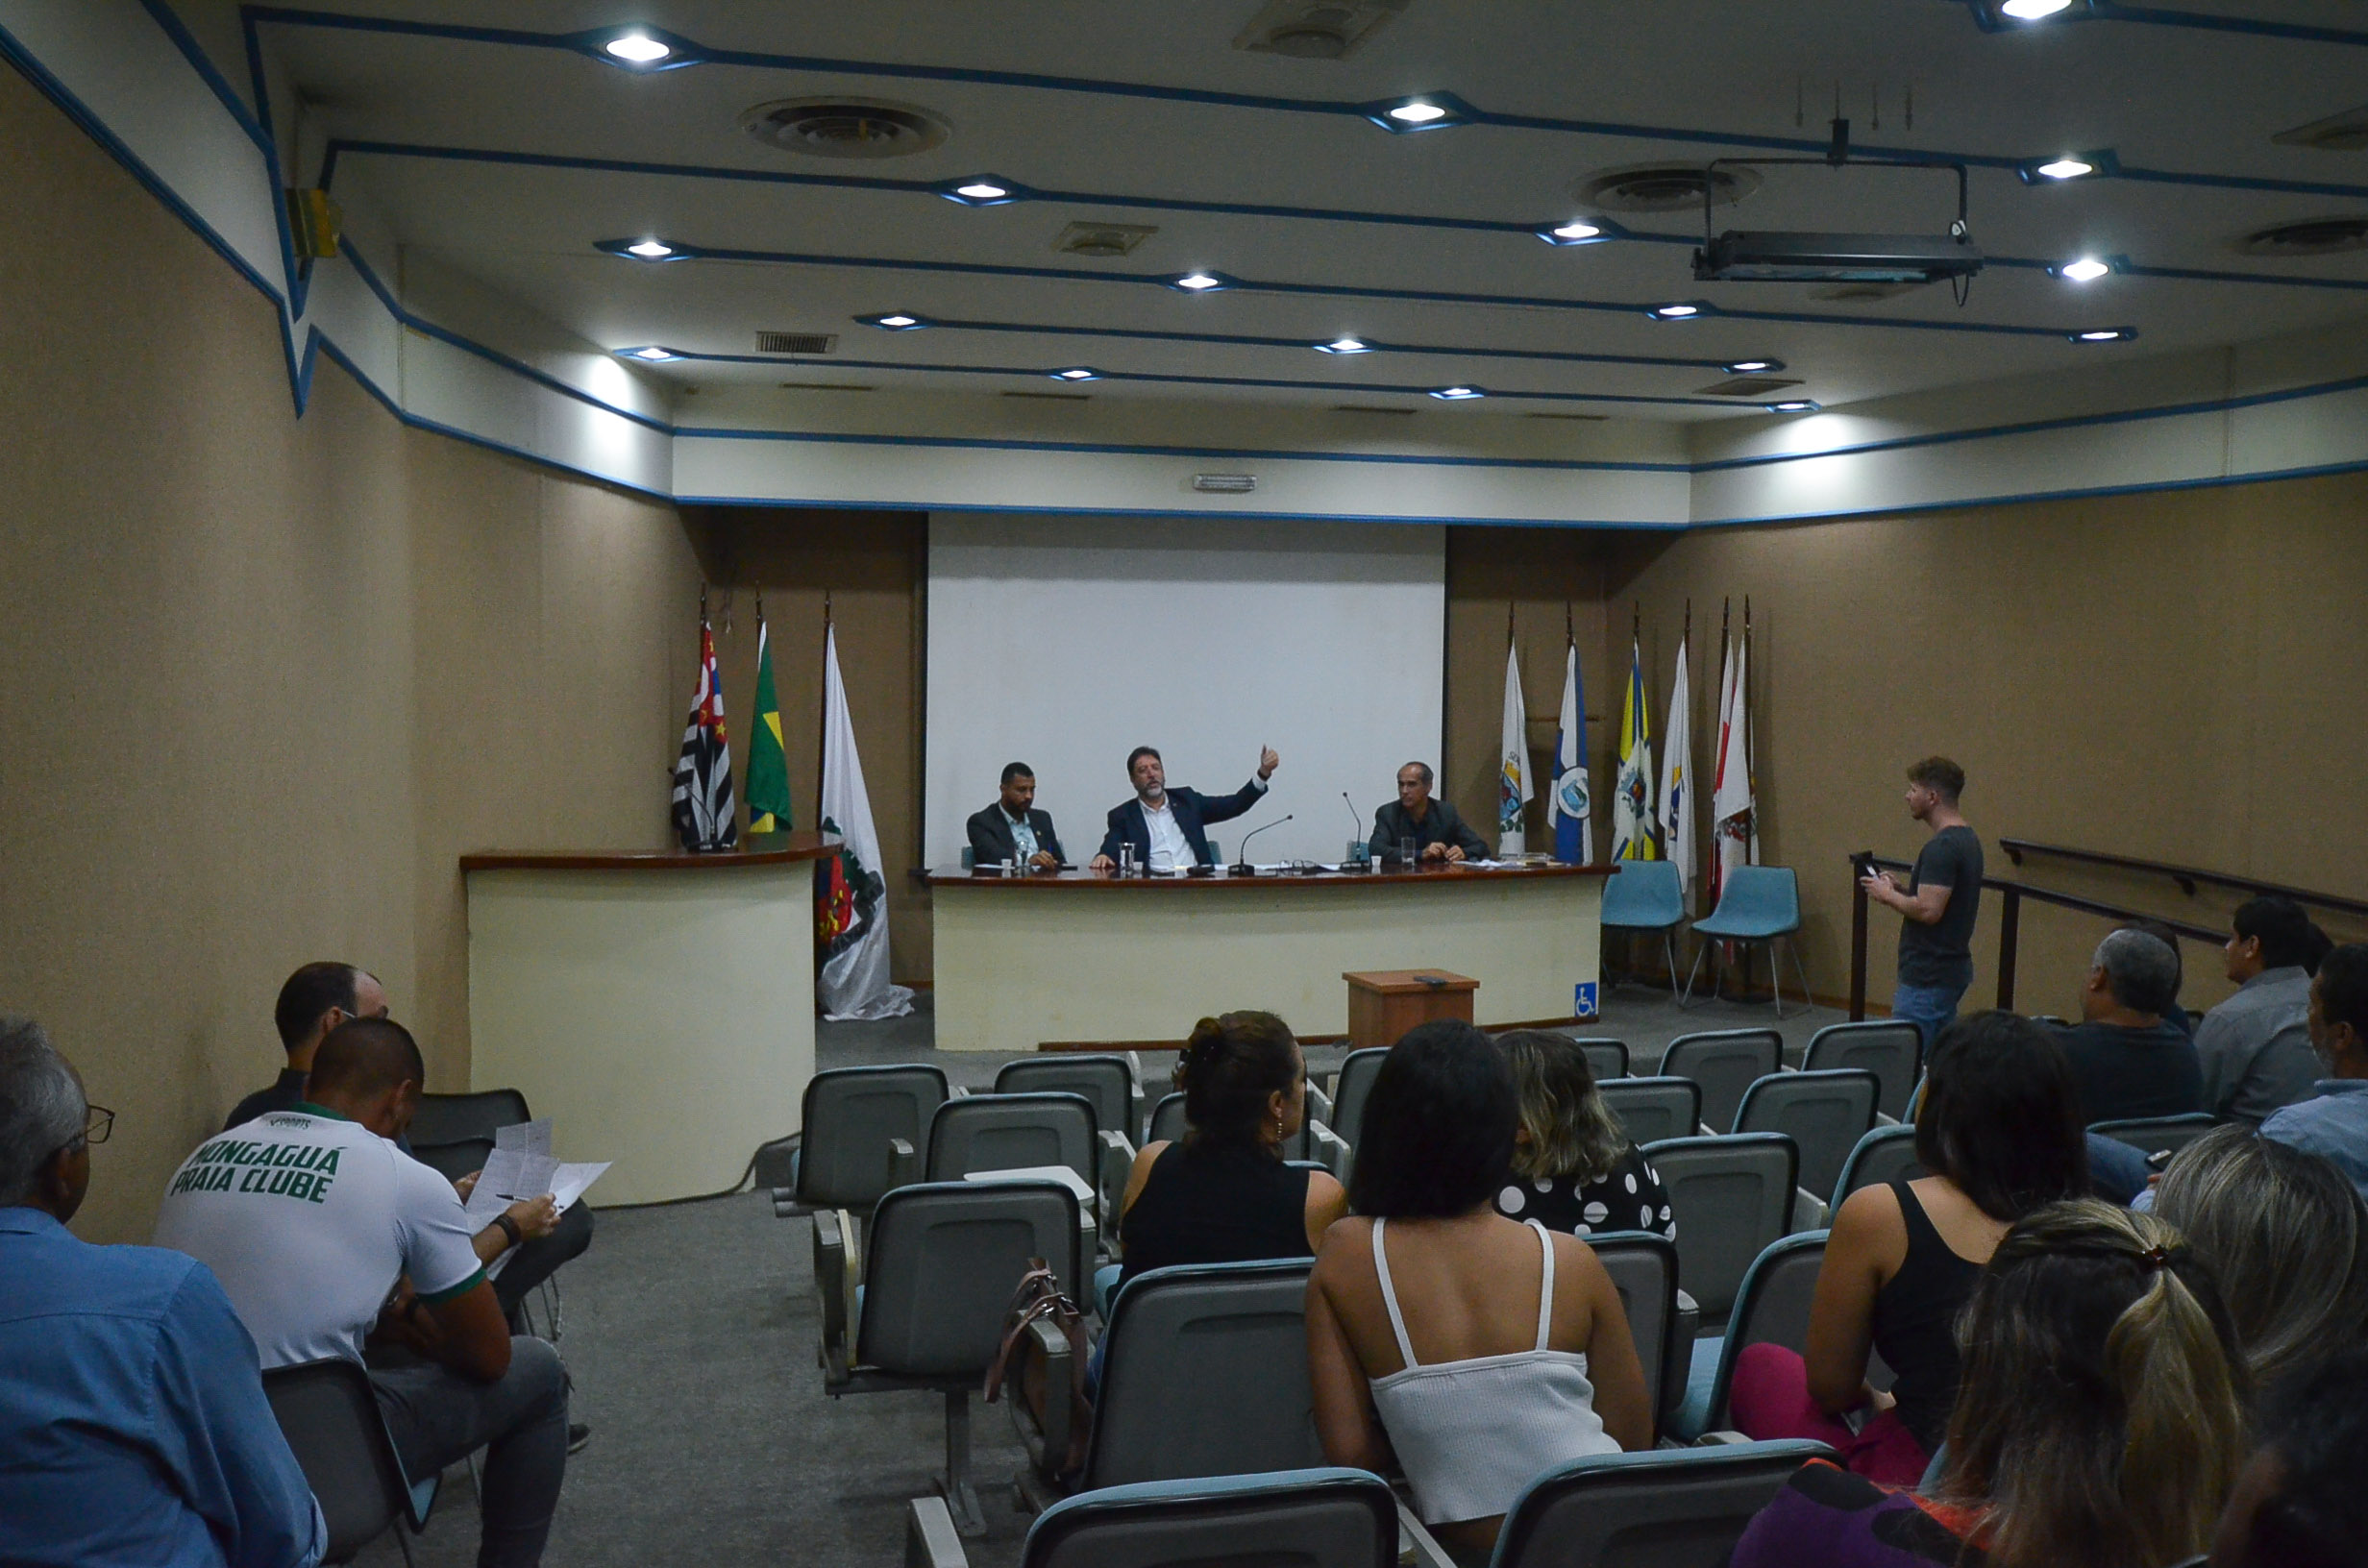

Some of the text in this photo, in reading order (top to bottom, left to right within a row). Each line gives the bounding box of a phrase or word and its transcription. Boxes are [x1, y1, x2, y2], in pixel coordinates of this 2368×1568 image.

[187, 1140, 347, 1175] MONGAGUÁ
[169, 1165, 333, 1204] PRAIA CLUBE
